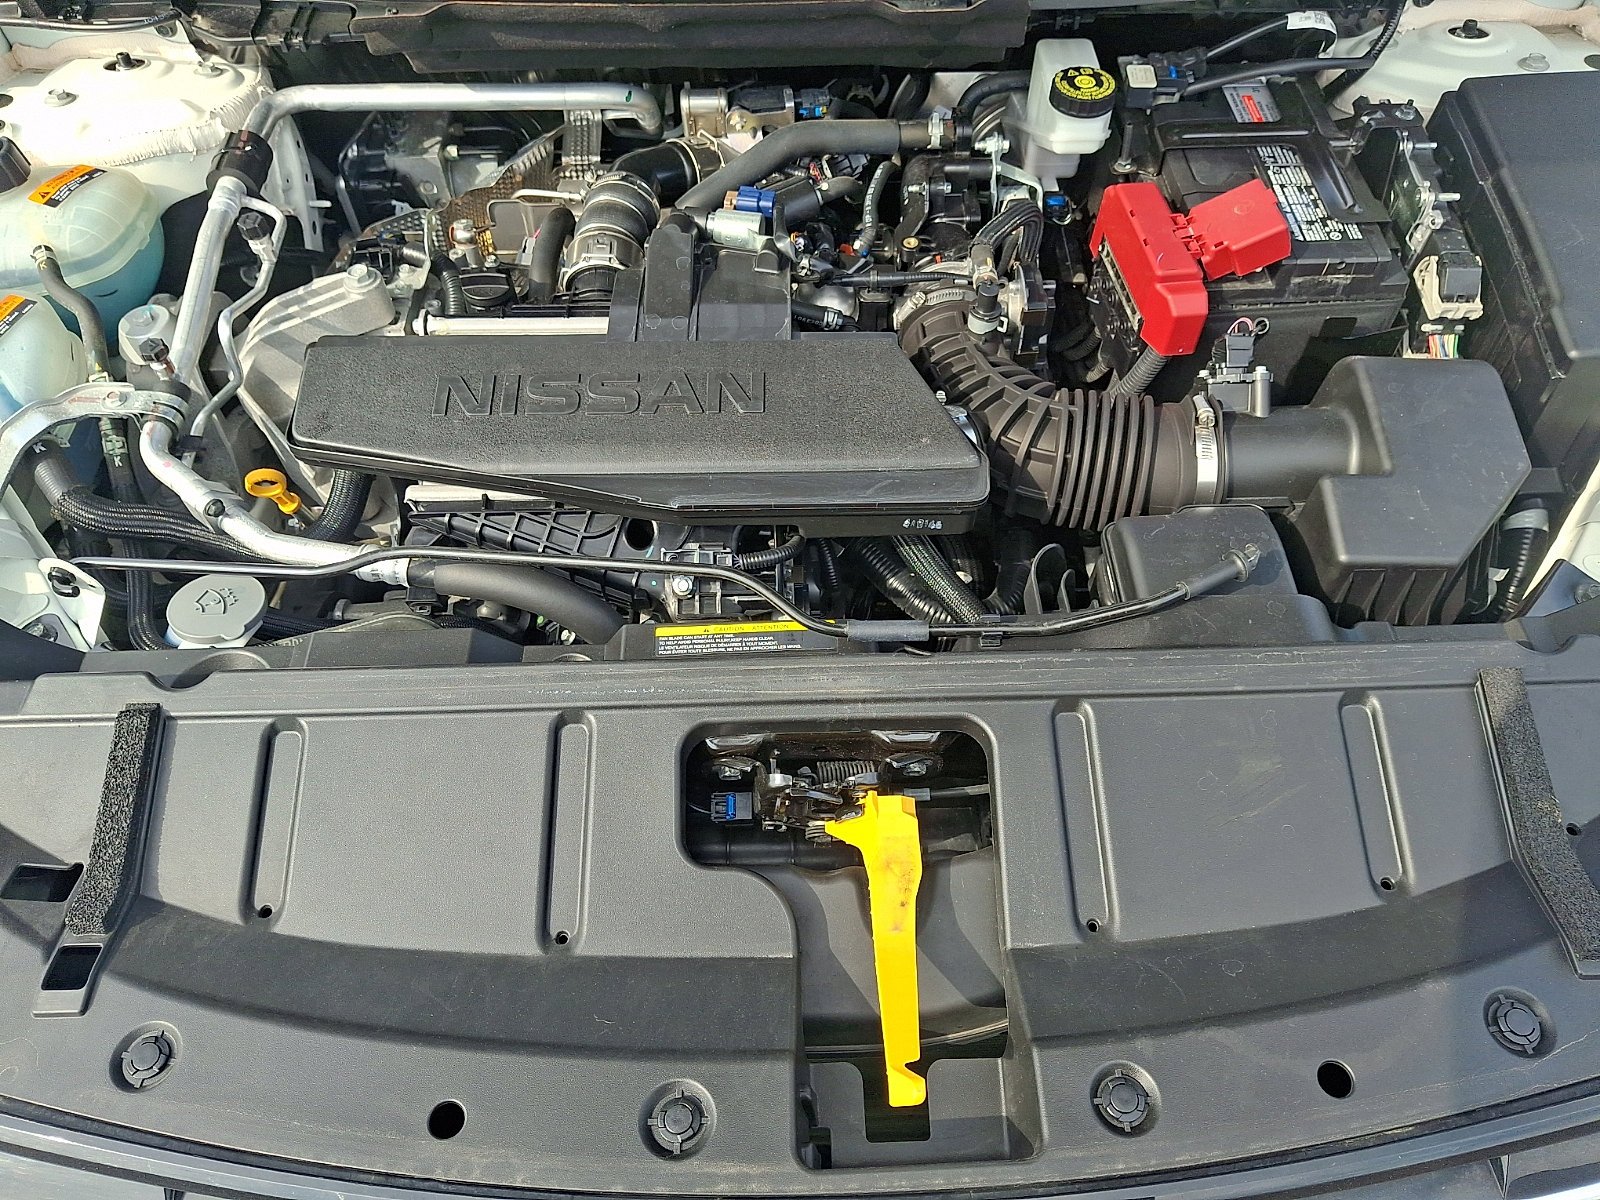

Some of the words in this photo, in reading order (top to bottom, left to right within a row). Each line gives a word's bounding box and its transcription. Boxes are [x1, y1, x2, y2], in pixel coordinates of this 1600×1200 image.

[431, 372, 766, 417] NISSAN
[32, 442, 47, 454] K
[114, 456, 122, 468] K
